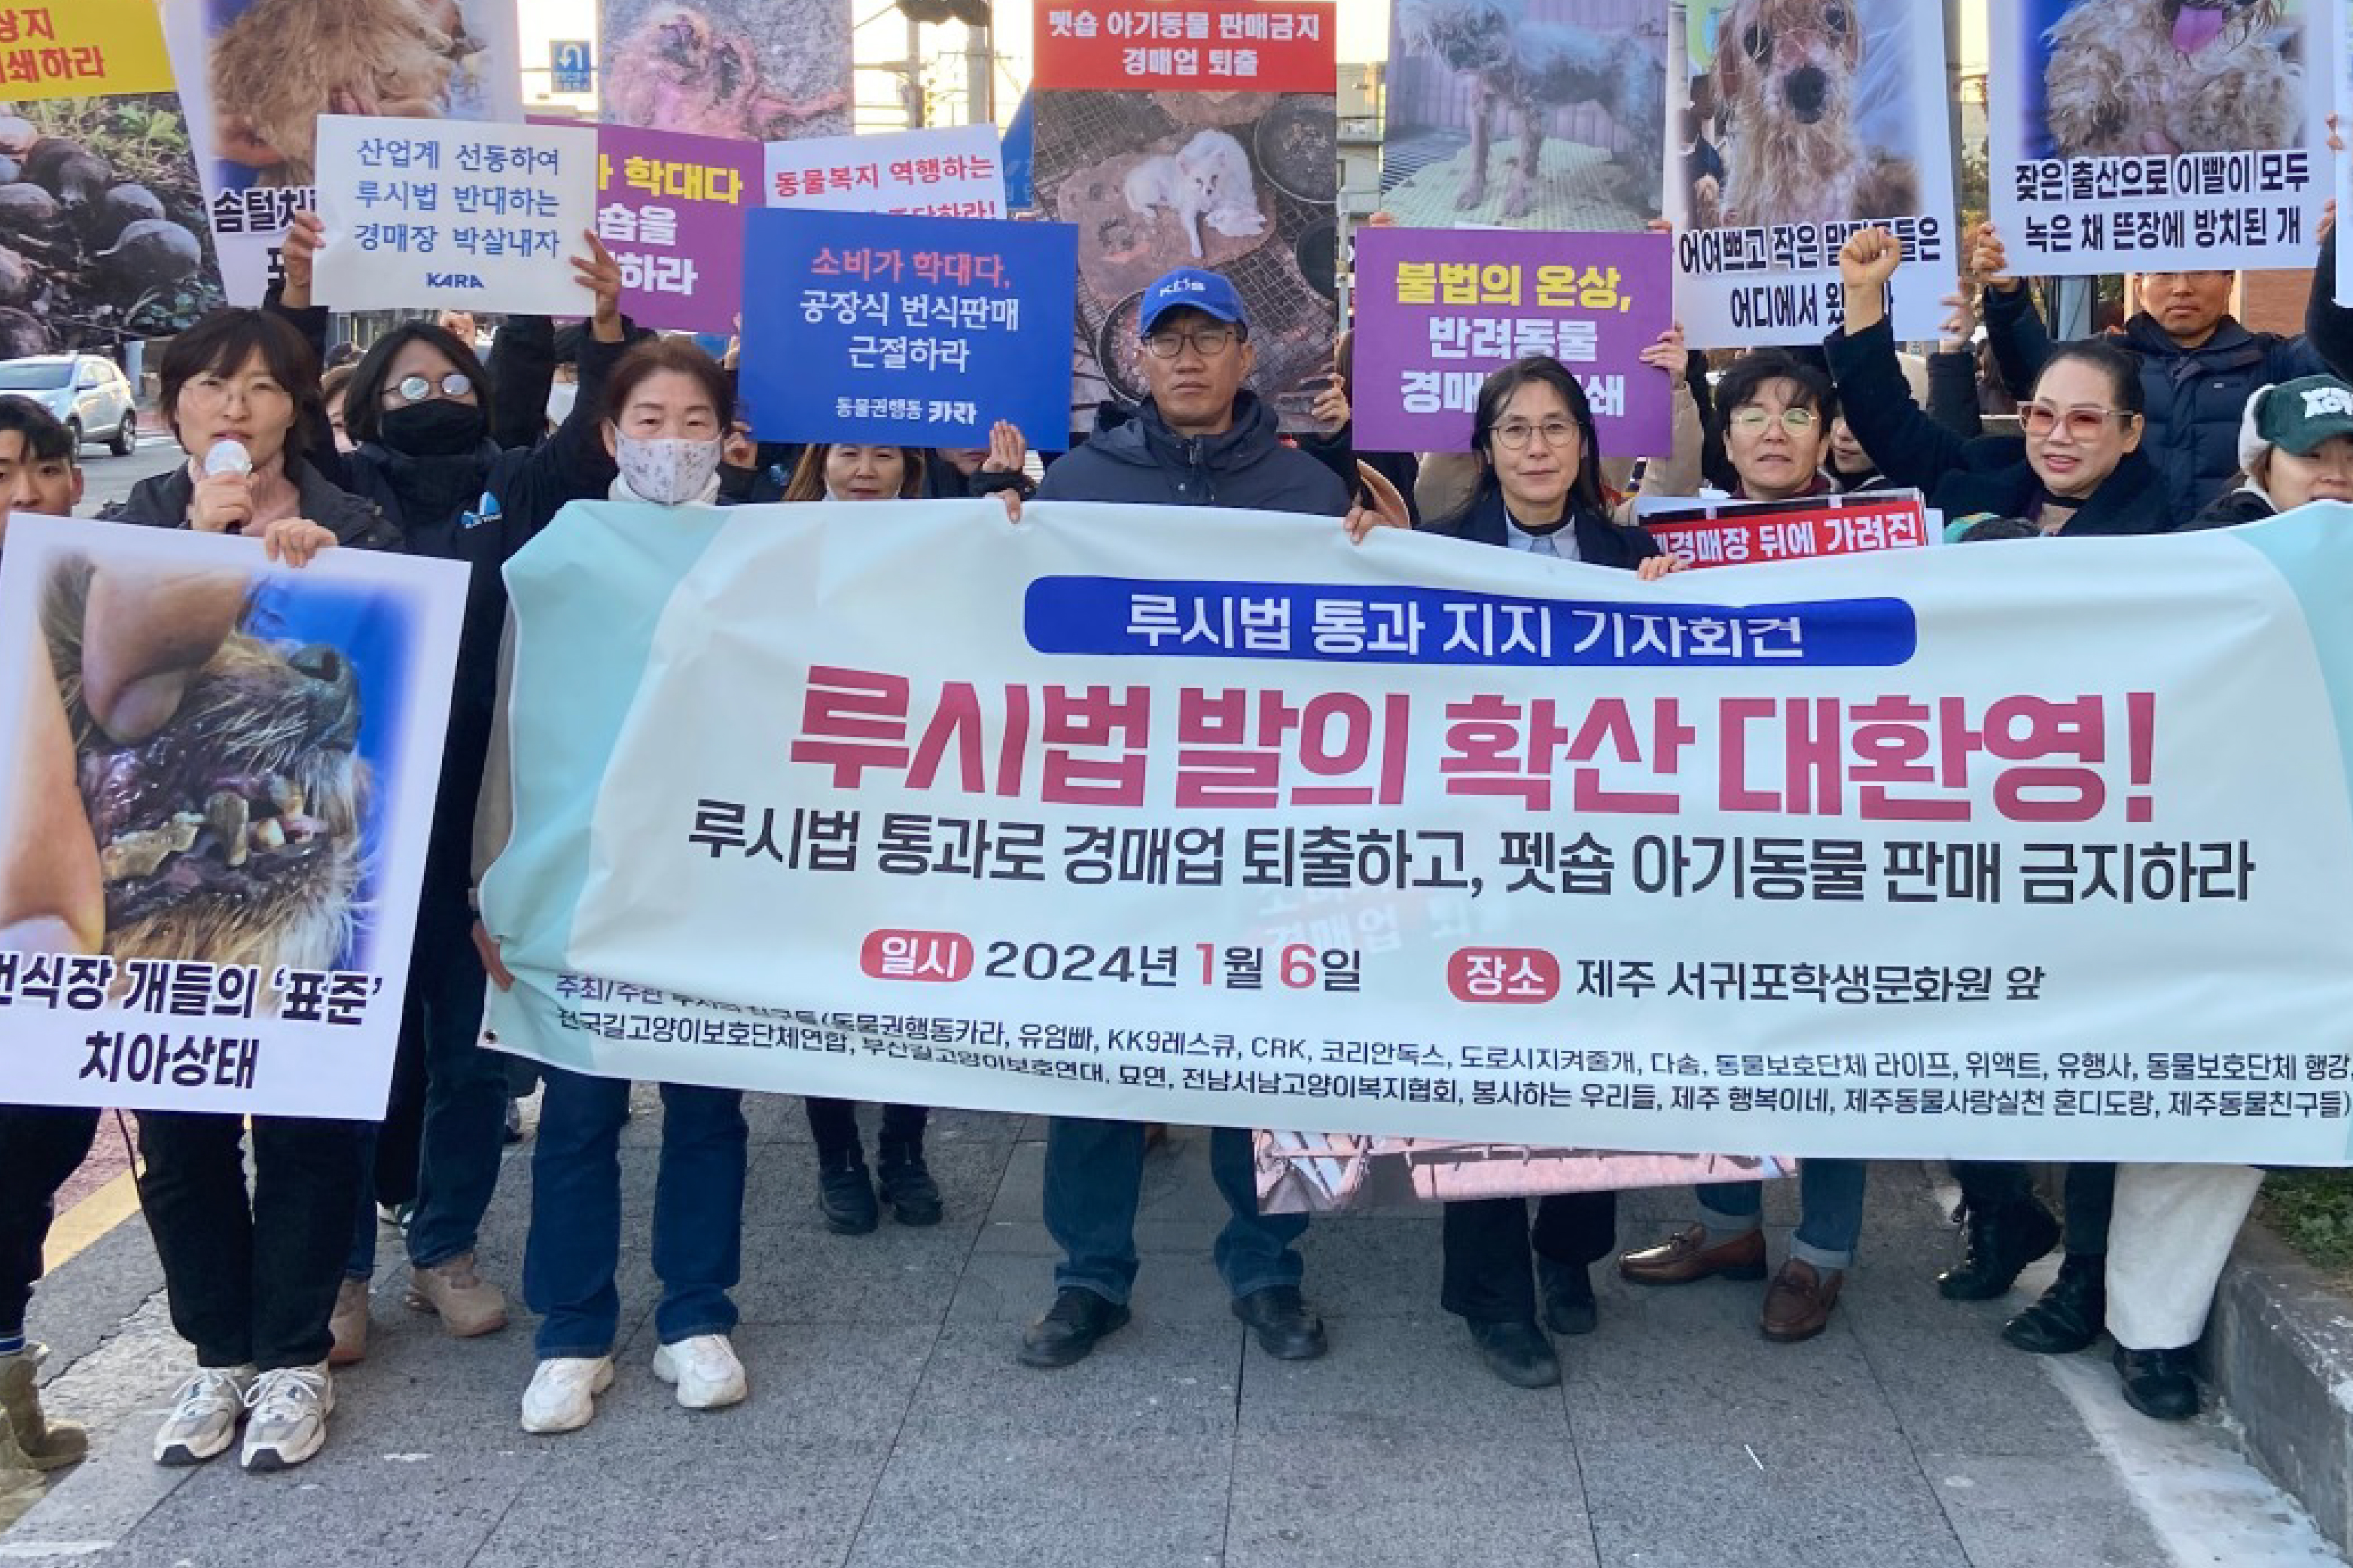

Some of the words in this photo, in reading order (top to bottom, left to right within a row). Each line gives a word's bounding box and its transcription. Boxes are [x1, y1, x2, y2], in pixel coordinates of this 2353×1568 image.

[1049, 9, 1099, 38] 펫숍
[1107, 11, 1209, 38] 아기동물
[1218, 12, 1319, 41] 판매금지
[0, 46, 105, 84] 쇄하라
[1123, 47, 1199, 76] 경매업
[1209, 49, 1259, 76] 퇴출
[357, 139, 439, 170] 산업계
[455, 143, 559, 175] 선동하여
[624, 154, 745, 205] 학대다
[776, 163, 878, 197] 동물복지
[888, 154, 994, 186] 역행하는
[2016, 163, 2062, 201] 잦은
[2071, 160, 2168, 198] 출산으로
[2178, 156, 2251, 196] 이빨이
[2260, 154, 2310, 192] 모두
[355, 181, 437, 210] 루시법
[452, 185, 559, 217] 반대하는
[354, 224, 440, 252] 경매장
[452, 228, 559, 259] 박살내자
[1679, 228, 1766, 273] 어여쁘고
[1773, 224, 1818, 269] 작은
[2025, 214, 2073, 252] 녹은
[2080, 213, 2104, 251] 채
[2114, 211, 2185, 249] 뜬장에
[2195, 207, 2267, 247] 방치된
[2276, 206, 2301, 245] 개
[425, 272, 486, 289] KARA
[810, 246, 905, 283] 소비가
[1396, 260, 1523, 306] 불법의
[1536, 264, 1632, 313] 온상,
[800, 289, 890, 327] 공장식
[901, 294, 1020, 332] 번식판매
[1731, 282, 1818, 328] 어디에서
[849, 336, 971, 373] 근절하라
[1429, 316, 1598, 362] 반려동물
[836, 396, 923, 421] 동물권행동
[928, 400, 979, 426] 카라
[1760, 521, 1815, 558] 뒤에
[1824, 513, 1918, 551] 가려진
[1126, 592, 1292, 652] 루시법
[1310, 598, 1425, 656] 통과
[1440, 603, 1553, 656] 지지
[791, 665, 1151, 806] 루시법
[1176, 688, 1410, 808] 발의
[1440, 693, 1696, 815] 확산
[1719, 692, 2154, 822] 대환영!
[688, 799, 860, 871] 루시법
[877, 813, 1046, 881] 통과로
[1063, 826, 1224, 887] 경매업
[1242, 827, 1483, 898] 퇴출하고,
[1500, 833, 1615, 894] 펫숍
[1632, 835, 1867, 900] 아기동물
[1882, 841, 2000, 903] 판매
[2019, 842, 2256, 903] 금지하라
[880, 936, 957, 979] 일시
[985, 941, 1179, 987] 2024년
[1196, 944, 1263, 989] 1월
[1279, 943, 1361, 991] 6일
[1466, 956, 1547, 995] 장소
[1576, 960, 1656, 1000] 제주
[1667, 962, 1992, 1003] 서귀포학생문화원
[2006, 967, 2045, 1001] 앞
[123, 963, 258, 1018] 개들의
[79, 1031, 260, 1088] 치아상태
[1017, 1023, 1099, 1054] 유엄빠,
[1108, 1028, 1242, 1060] KK9레스큐,
[1251, 1037, 1312, 1062] CRK,
[1321, 1040, 1452, 1070] 코리안독스,
[1459, 1045, 1642, 1075] 도로시지켜줄개,
[1651, 1052, 1708, 1077] 다솜,
[1716, 1053, 1867, 1078] 동물보호단체
[1874, 1052, 1958, 1081] 라이프,
[1966, 1052, 2048, 1080] 위액트,
[2057, 1052, 2138, 1082] 유행사,
[2146, 1052, 2296, 1081] 동물보호단체
[1119, 1064, 1175, 1090] 묘연,
[1183, 1066, 1463, 1106] 전남서남고양이복지협회,
[1472, 1079, 1573, 1108] 봉사하는
[1580, 1082, 1663, 1112] 우리들,
[1670, 1085, 1720, 1112] 제주
[1727, 1086, 1836, 1115] 행복이네,
[1843, 1086, 2045, 1116] 제주동물사랑실천
[2053, 1088, 2160, 1119] 혼디도랑,
[2168, 1090, 2351, 1119] 제주동물친구들)
